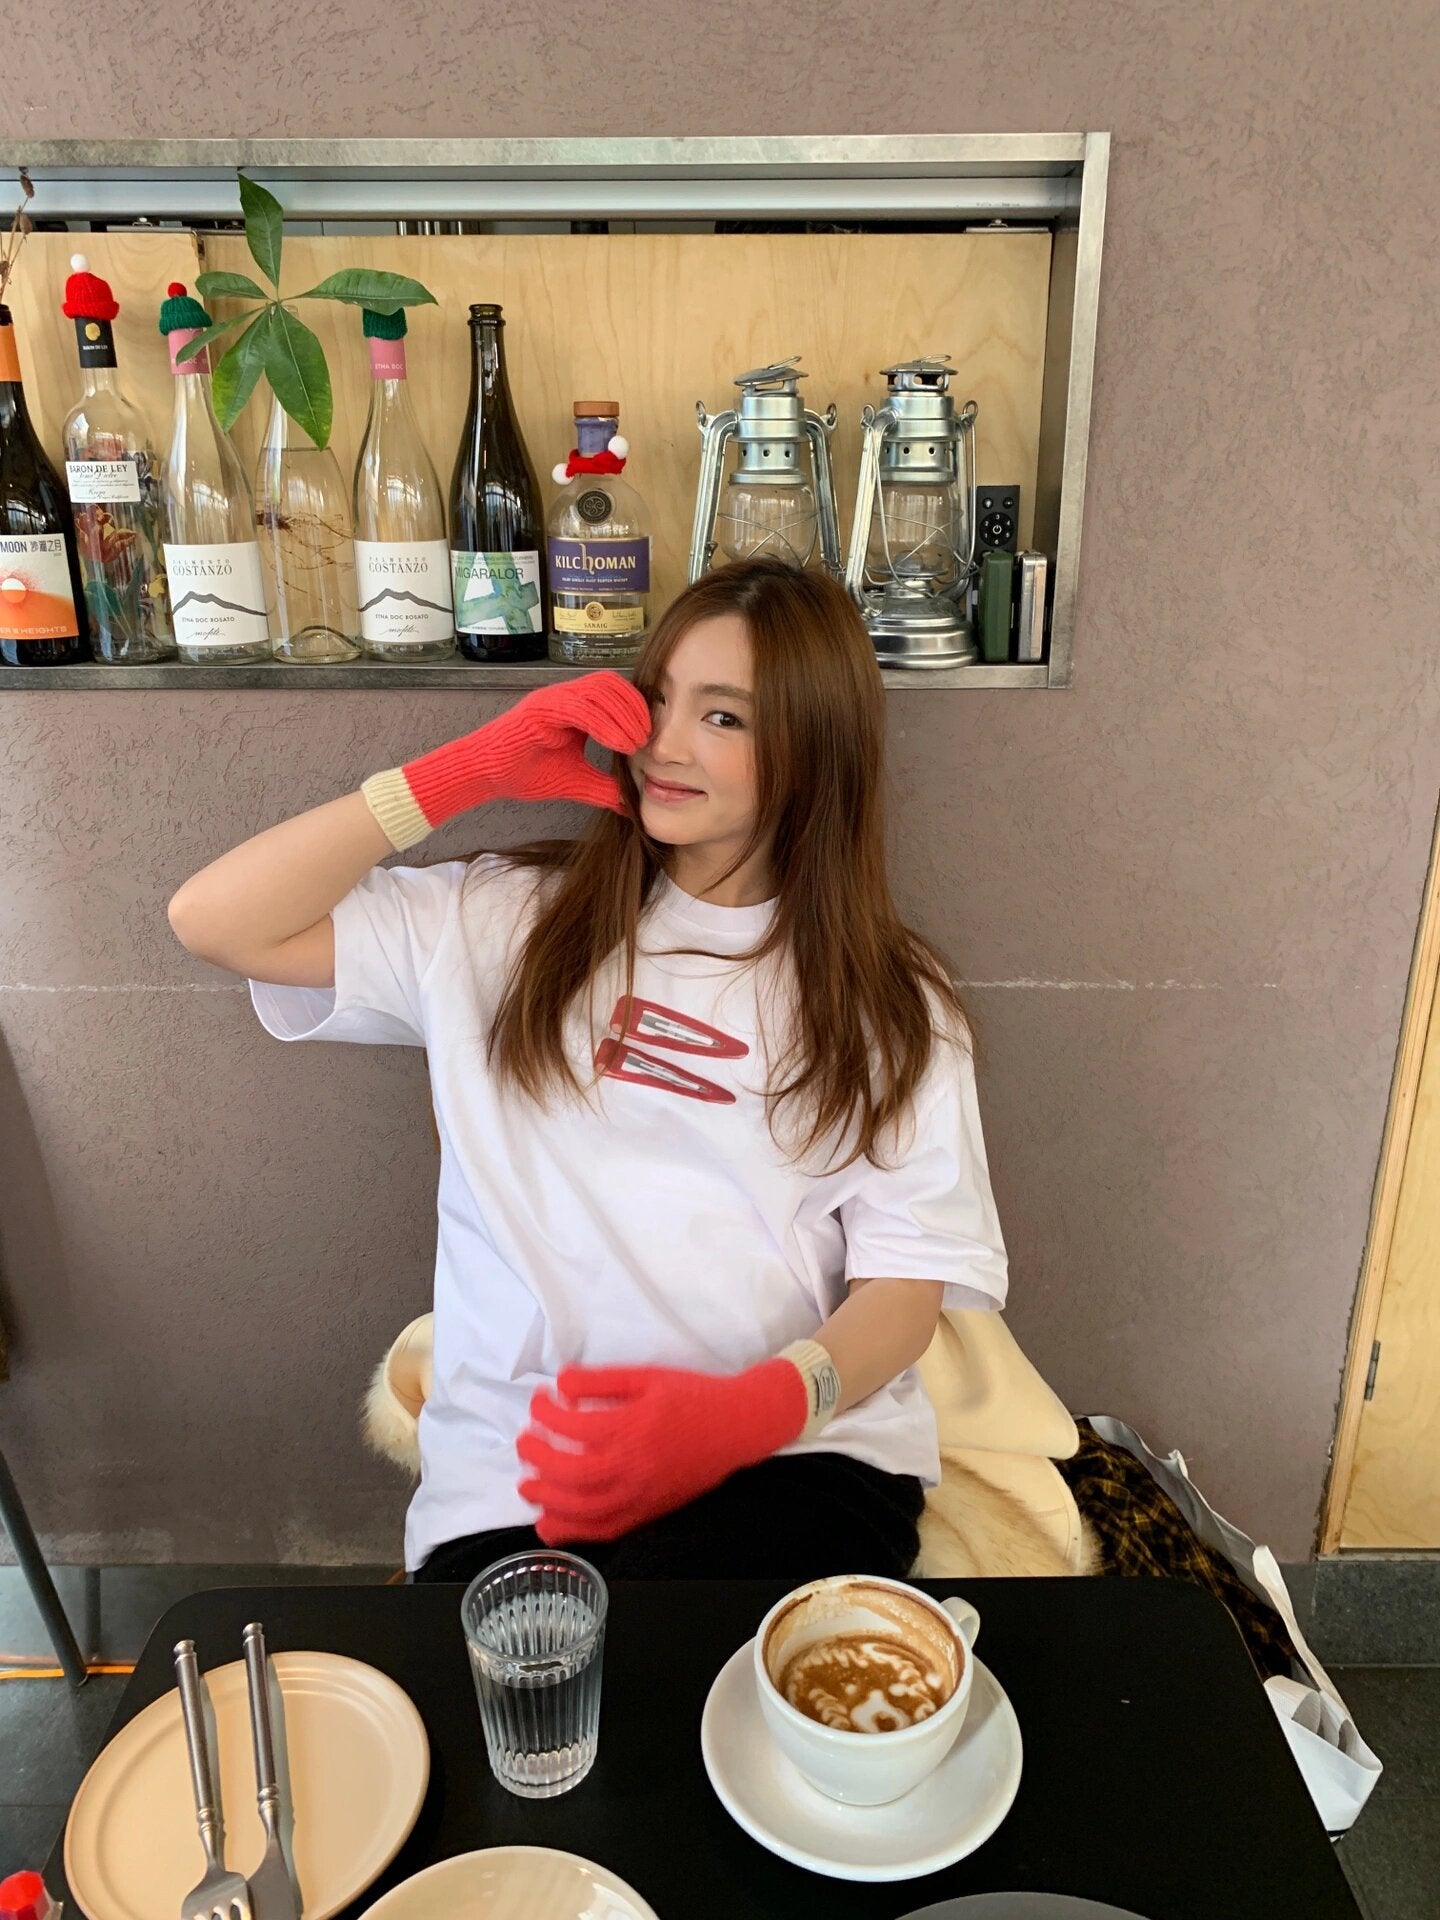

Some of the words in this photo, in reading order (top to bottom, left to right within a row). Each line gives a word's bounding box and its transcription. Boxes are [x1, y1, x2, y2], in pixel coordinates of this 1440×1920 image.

[69, 464, 94, 474] BARON
[95, 464, 108, 473] DE
[111, 464, 128, 473] LEY
[0, 540, 28, 553] MOON
[172, 564, 233, 576] COSTANZO
[368, 562, 429, 574] COSTANZO
[20, 625, 68, 635] HEIGHTS
